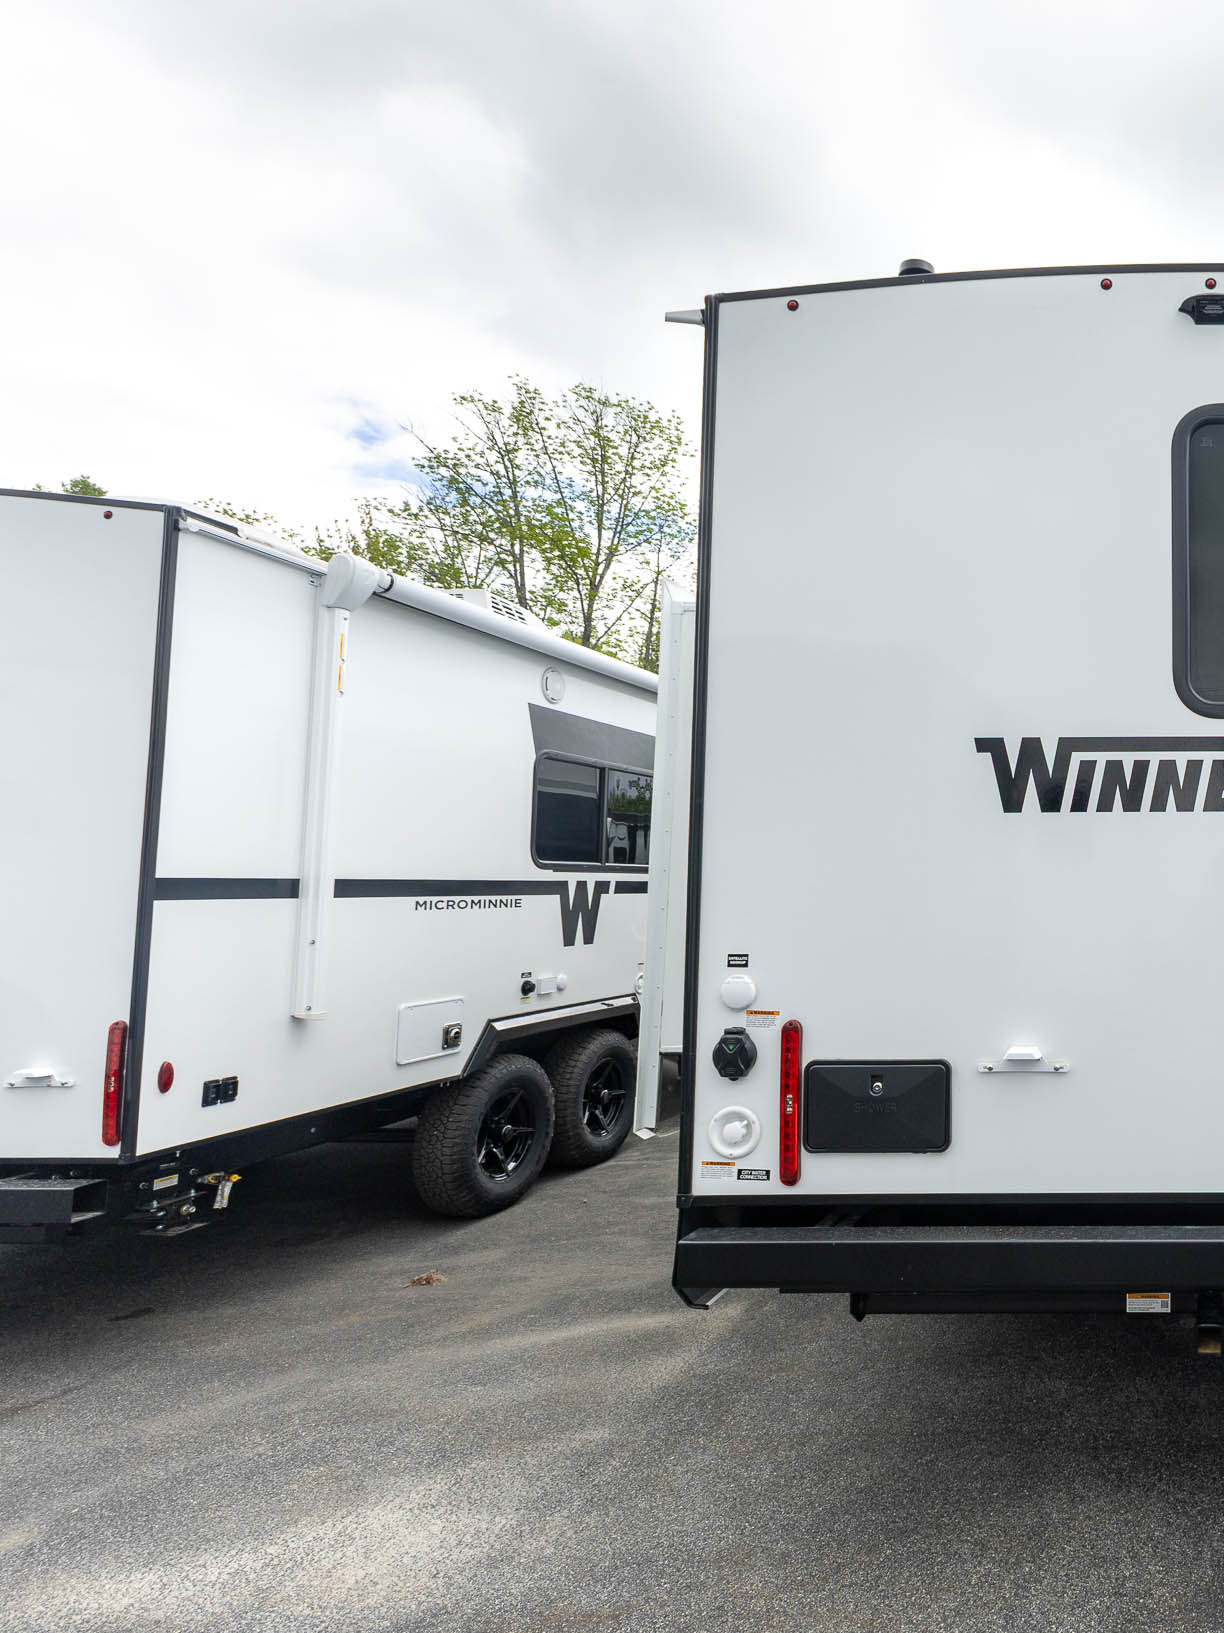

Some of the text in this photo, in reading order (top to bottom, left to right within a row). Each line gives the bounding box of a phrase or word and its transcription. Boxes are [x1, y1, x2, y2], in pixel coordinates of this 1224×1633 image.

[414, 898, 523, 911] MICROMINNIE
[559, 880, 611, 947] W
[853, 1102, 897, 1113] SHOWER
